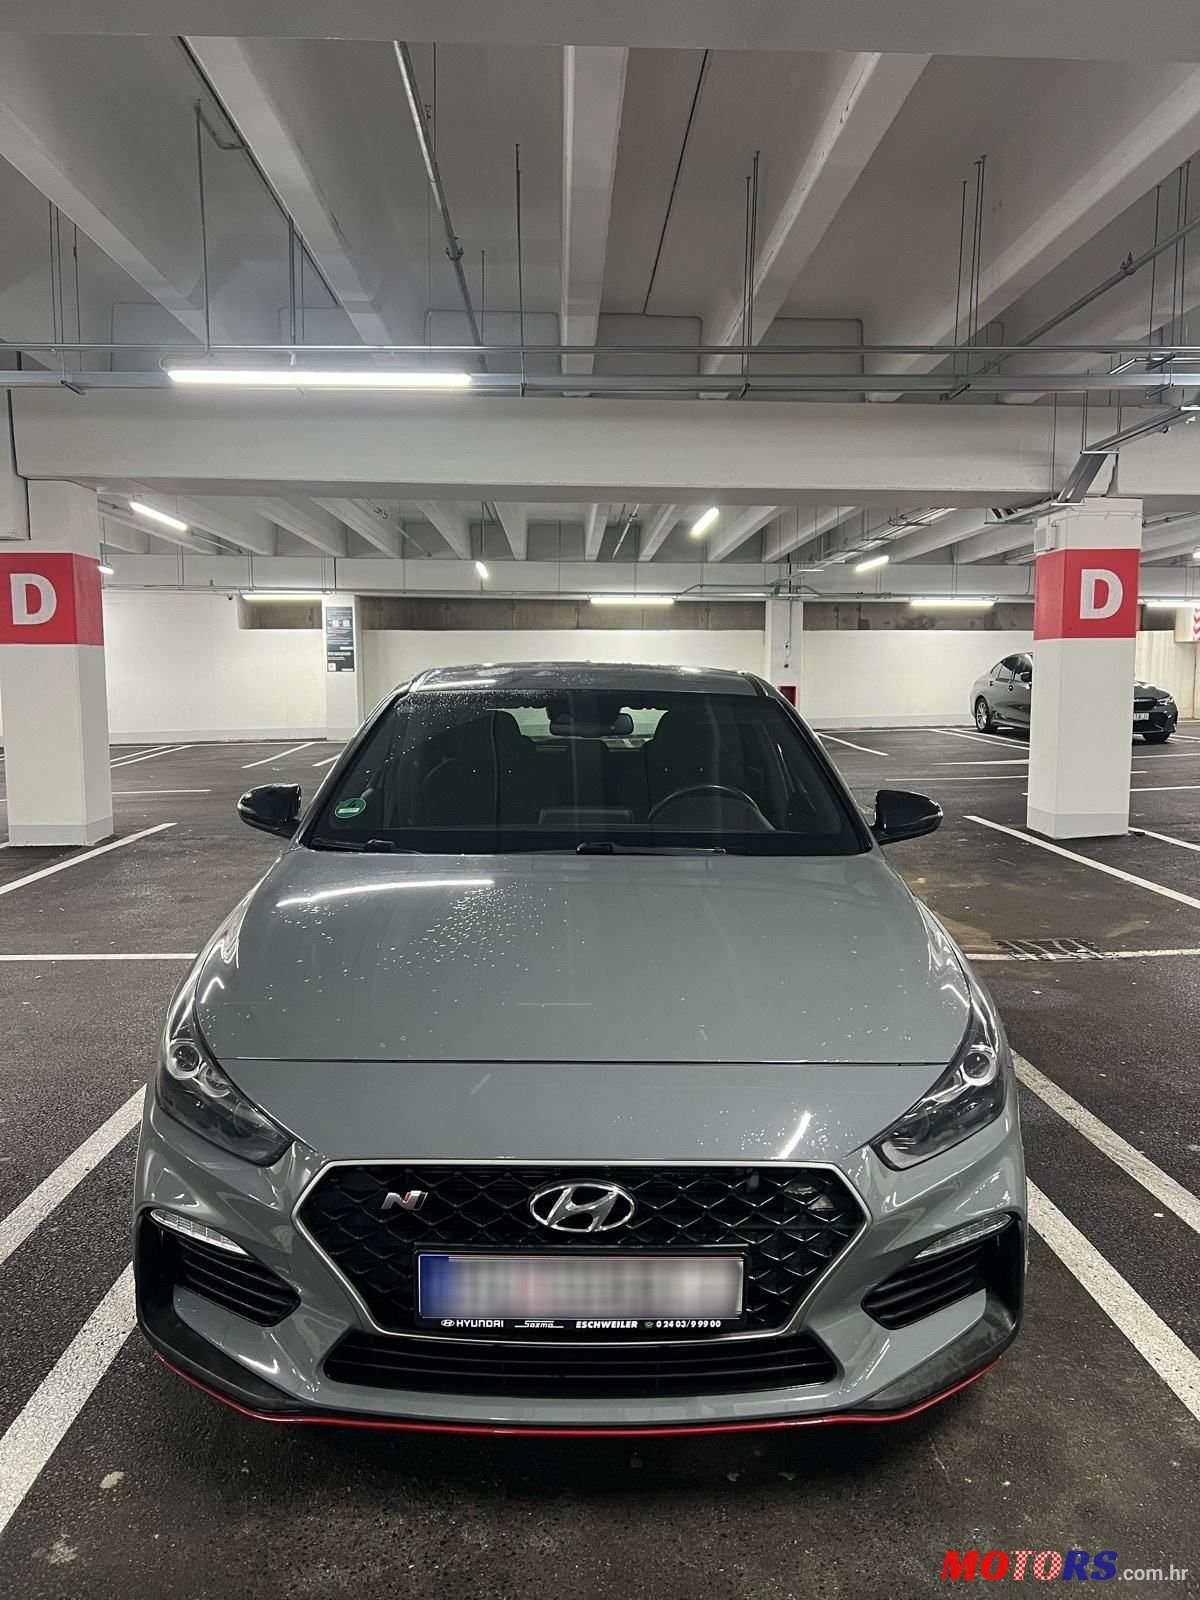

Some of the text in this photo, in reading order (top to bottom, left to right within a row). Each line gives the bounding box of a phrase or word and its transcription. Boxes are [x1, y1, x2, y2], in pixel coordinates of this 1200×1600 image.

[9, 573, 57, 625] D
[1080, 568, 1124, 620] D
[456, 1319, 504, 1328] HYUNDAI
[576, 1320, 639, 1329] ESCHWEILER
